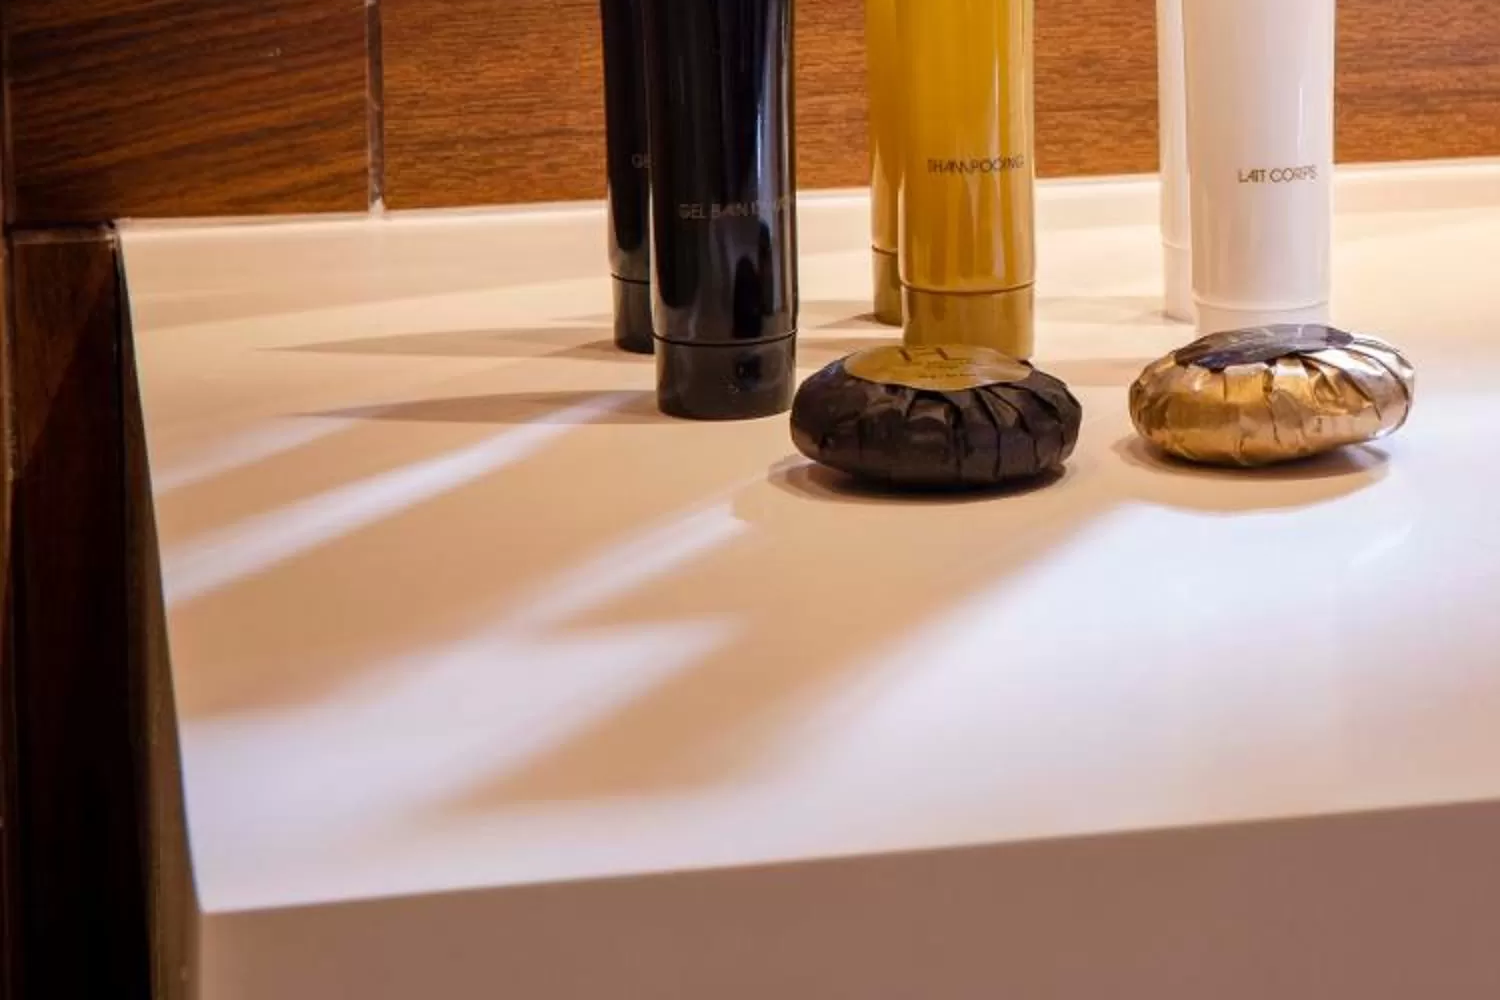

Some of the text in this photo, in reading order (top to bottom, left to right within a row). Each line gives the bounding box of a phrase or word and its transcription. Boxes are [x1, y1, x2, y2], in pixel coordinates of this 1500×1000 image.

[1238, 165, 1318, 183] LAIT CORPS
[679, 203, 706, 220] GEL
